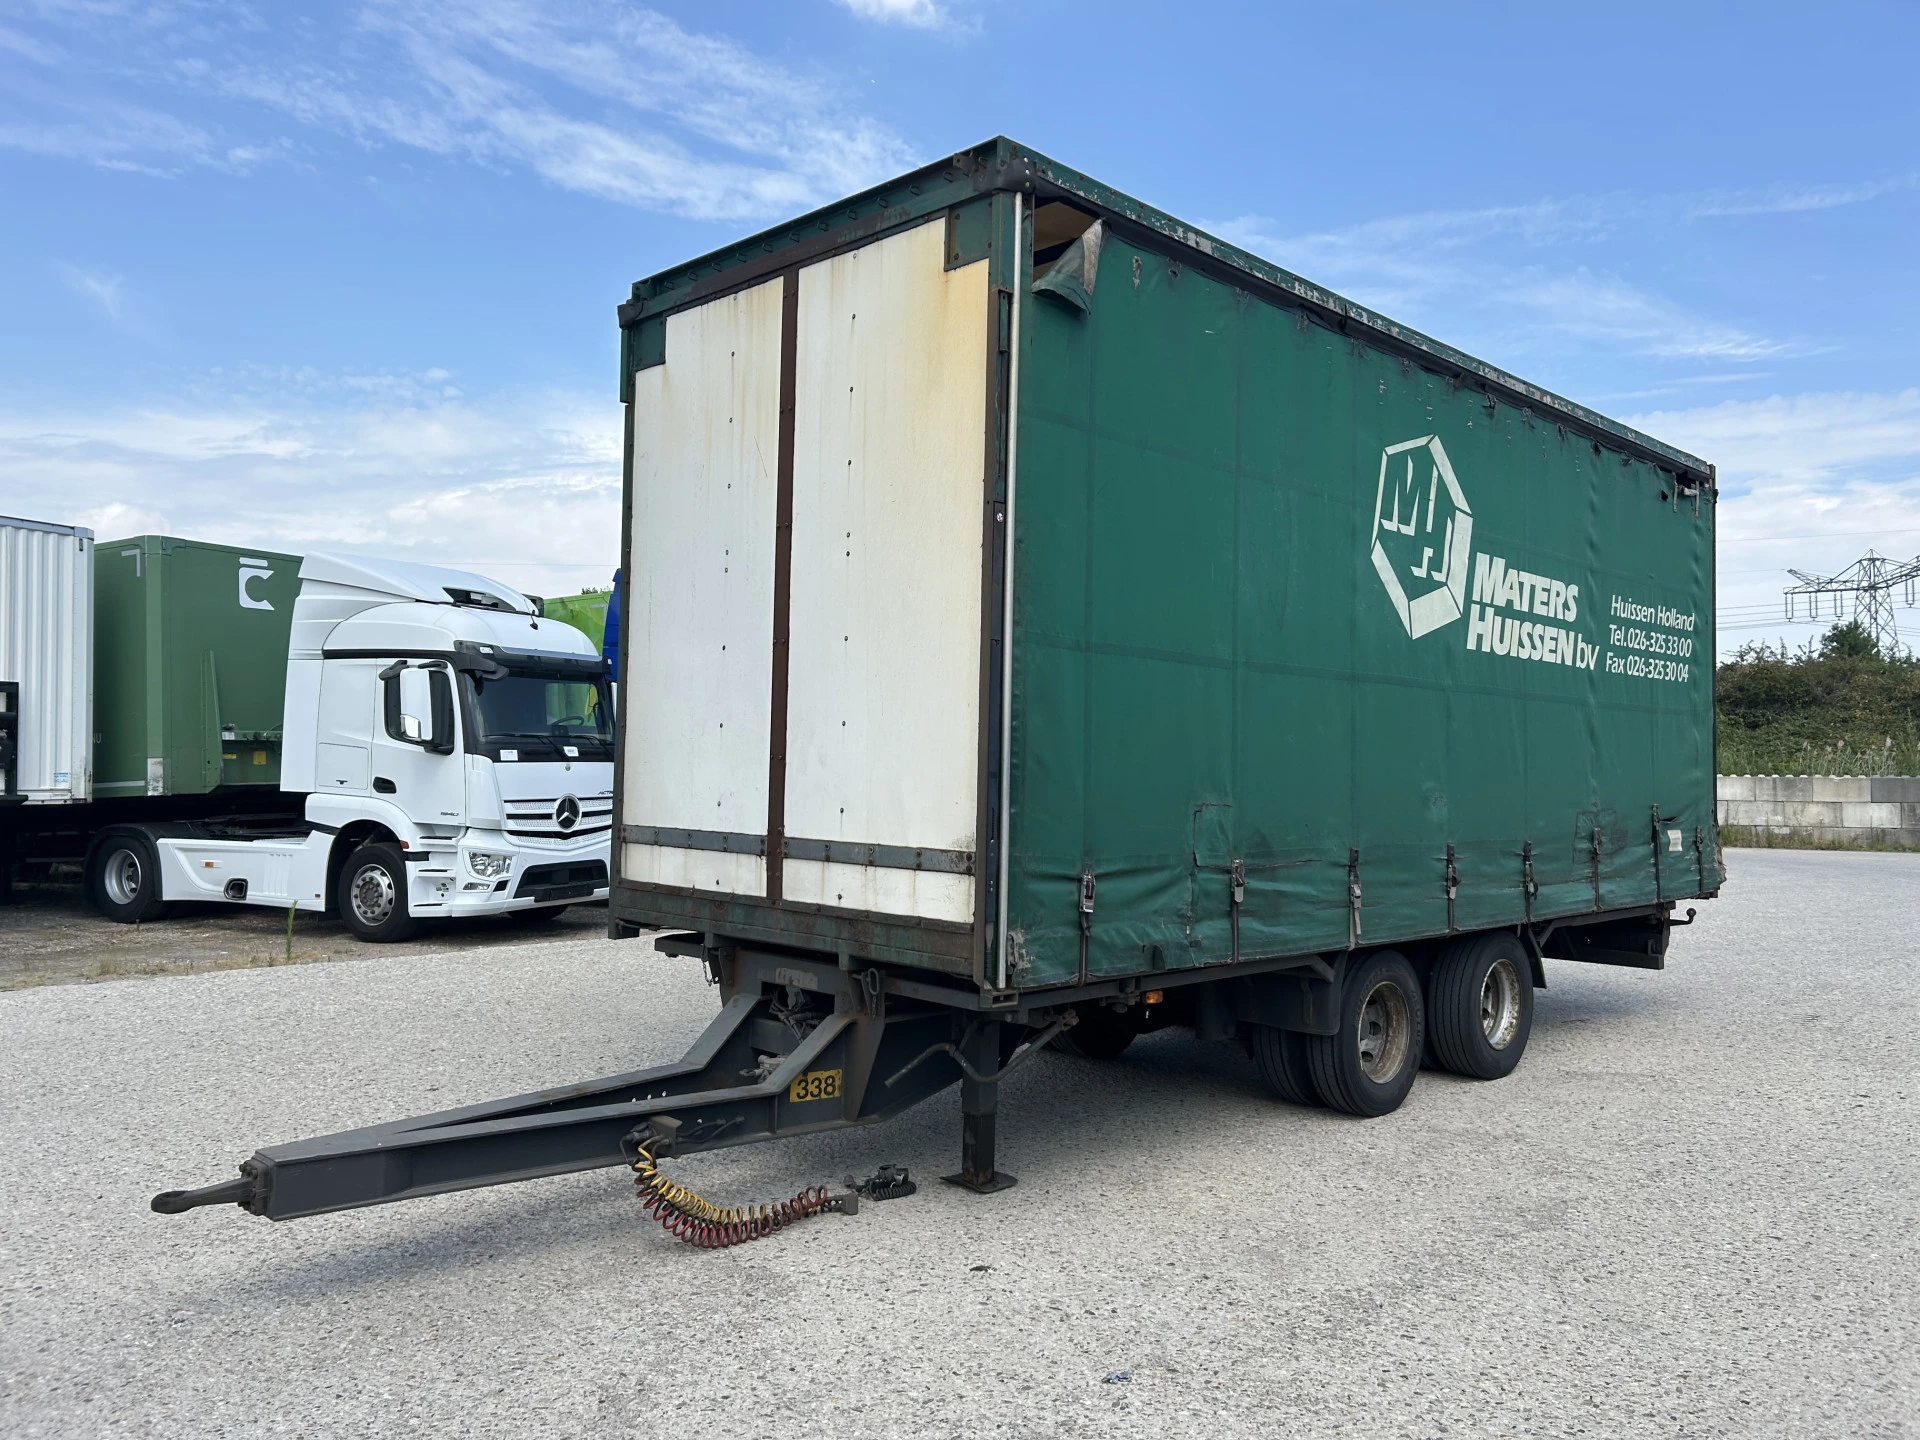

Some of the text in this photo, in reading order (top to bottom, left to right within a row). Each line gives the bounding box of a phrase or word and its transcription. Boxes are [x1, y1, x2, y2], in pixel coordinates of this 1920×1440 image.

[1472, 551, 1579, 623] MATERS
[1610, 594, 1696, 632] Huissen Holland
[1466, 603, 1600, 671] HUISSEN bv
[1605, 651, 1626, 674] Fax
[1626, 654, 1665, 680] 026-325
[796, 1075, 837, 1100] 338
